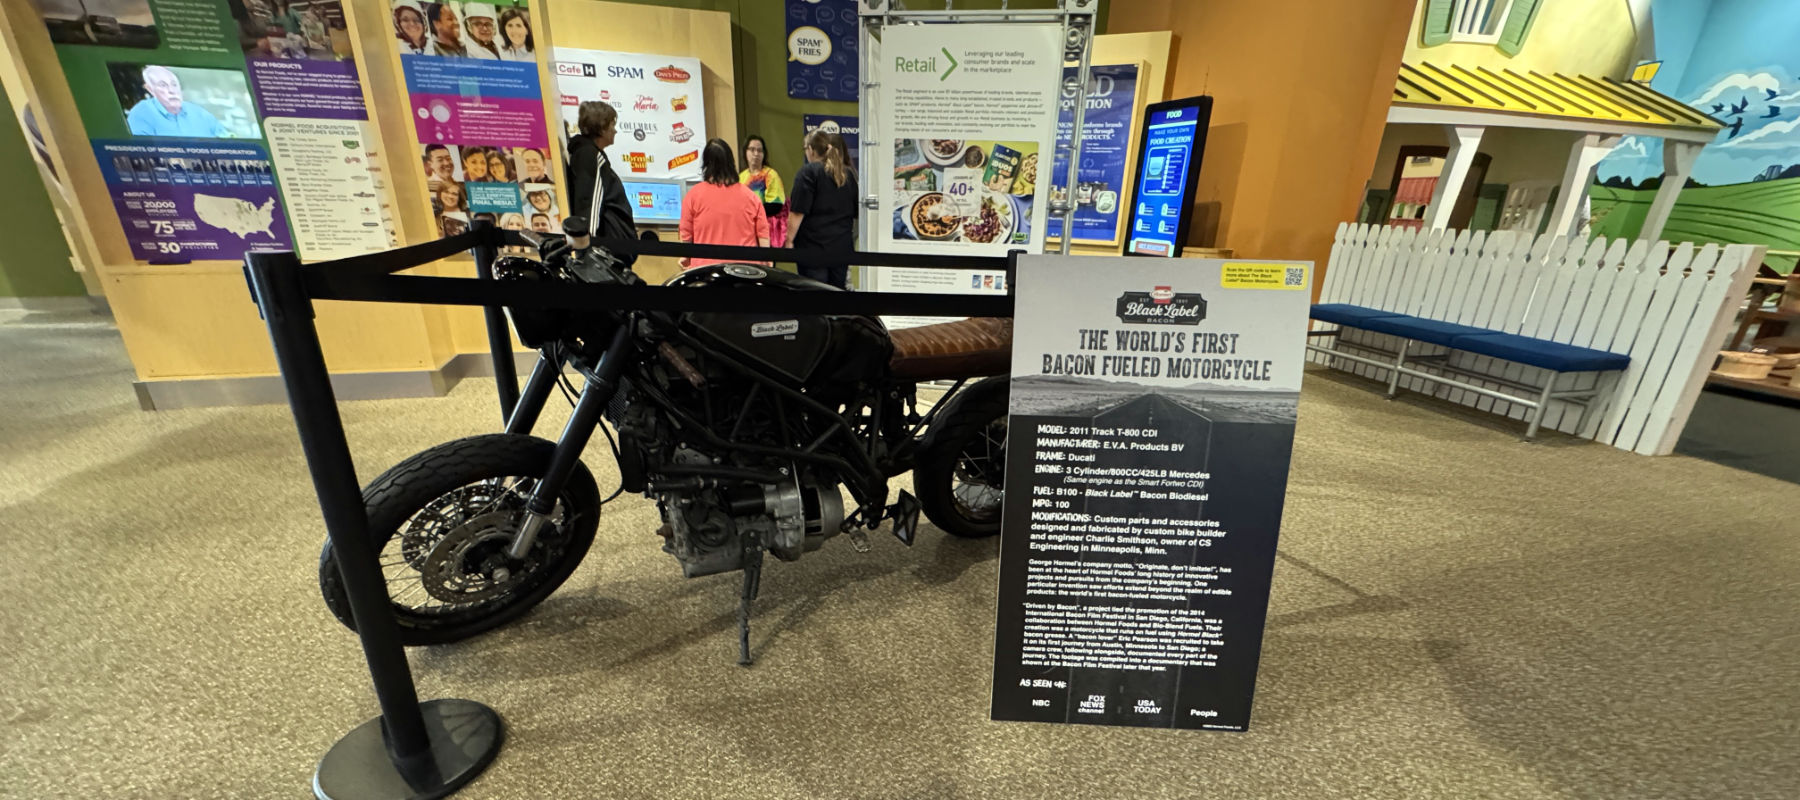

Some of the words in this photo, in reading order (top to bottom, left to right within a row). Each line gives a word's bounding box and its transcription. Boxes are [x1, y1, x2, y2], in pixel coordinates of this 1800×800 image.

[798, 48, 822, 56] FRIES
[559, 64, 581, 74] Café
[895, 56, 936, 72] Retail
[608, 66, 644, 80] SPAM
[1166, 110, 1182, 119] FOOD
[620, 122, 658, 132] COLUMBUS
[1150, 138, 1164, 146] FOOD
[1165, 136, 1192, 144] CREATION
[950, 183, 974, 196] 40+
[144, 201, 175, 209] 20,000
[150, 220, 174, 234] 75
[158, 242, 181, 254] 30
[1124, 302, 1162, 316] Black
[1164, 303, 1199, 318] Label
[776, 324, 794, 332] Label
[1079, 329, 1108, 350] THE
[1116, 330, 1186, 353] WORLD'S
[1192, 333, 1239, 354] FIRST
[1042, 354, 1096, 375] BACON
[1102, 356, 1161, 377] FUELED
[1166, 358, 1272, 381] MOTORCYCLE
[1037, 424, 1066, 434] MODEL:
[1092, 427, 1114, 435] Track
[1117, 428, 1139, 436] T-800
[1142, 428, 1157, 437] CDI
[1036, 437, 1100, 448] MANUFACTURER:
[1103, 441, 1128, 449] E.V.A.
[1130, 442, 1168, 451] Products
[1171, 443, 1184, 451] BV
[1036, 450, 1065, 461] FRAME:
[1068, 453, 1095, 461] Ducati
[1035, 464, 1063, 474] ENGINE:
[1073, 467, 1166, 477] Cylinder/800CC/425LB
[1169, 470, 1210, 479] Mercedes
[1138, 478, 1159, 486] Smart
[1187, 480, 1204, 488] CDI)
[1033, 486, 1053, 495] FUEL:
[1056, 487, 1077, 495] B100
[1140, 491, 1166, 499] Bacon
[1169, 492, 1208, 500] Biodiesel
[1032, 498, 1052, 508] MPG:
[1056, 500, 1069, 508] 100
[1031, 511, 1091, 522] MODIFICATIONS:
[1094, 515, 1126, 523] Custom
[1128, 517, 1149, 525] parts
[1169, 519, 1219, 527] accessories
[1031, 522, 1068, 532] designed
[1088, 525, 1129, 533] fabricated
[1131, 526, 1142, 535] by
[1177, 528, 1194, 536] bike
[1196, 529, 1226, 537] builder
[1048, 534, 1083, 542] engineer
[1086, 534, 1114, 542] Charlie
[1117, 535, 1158, 544] Smithson,
[1198, 538, 1211, 546] CS
[1030, 542, 1078, 552] Engineering
[1090, 544, 1142, 554] Minneapolis,
[1144, 546, 1166, 554] Minn.
[1029, 558, 1051, 566] George
[1019, 678, 1030, 687] AS
[1033, 680, 1052, 688] SEEN
[1032, 699, 1050, 707] NBC
[1134, 706, 1162, 714] TODAY
[1190, 709, 1218, 718] People
